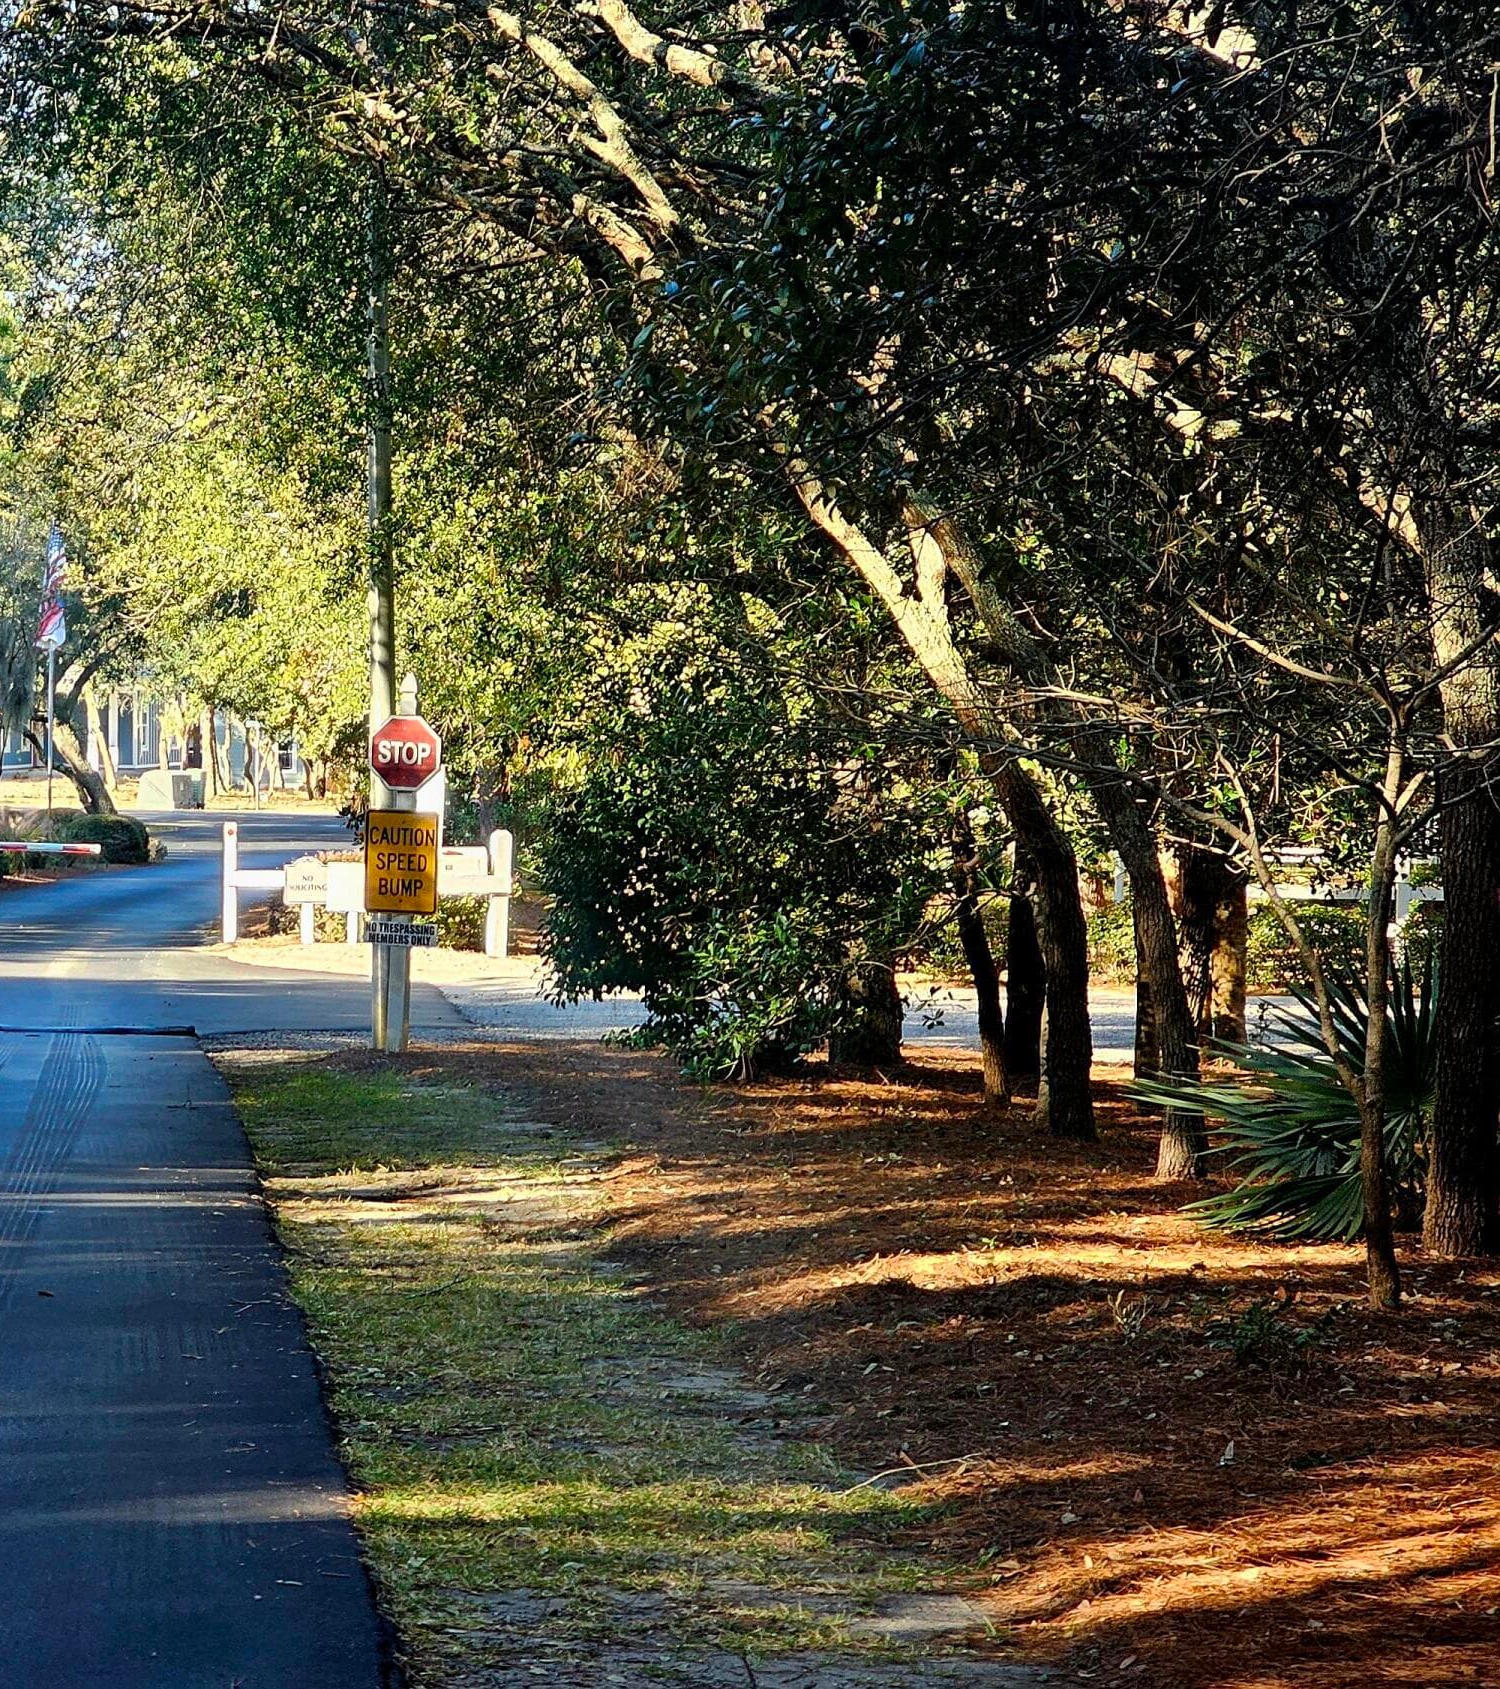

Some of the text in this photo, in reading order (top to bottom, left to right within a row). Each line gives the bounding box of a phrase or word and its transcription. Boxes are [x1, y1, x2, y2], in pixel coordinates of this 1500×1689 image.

[378, 740, 431, 765] STOP
[370, 826, 435, 847] CAUTION
[376, 852, 427, 872] SPEED
[378, 877, 423, 897] BUMP
[366, 922, 435, 936] NO TRESPASSING
[368, 932, 431, 946] MEMBERS ONLY
